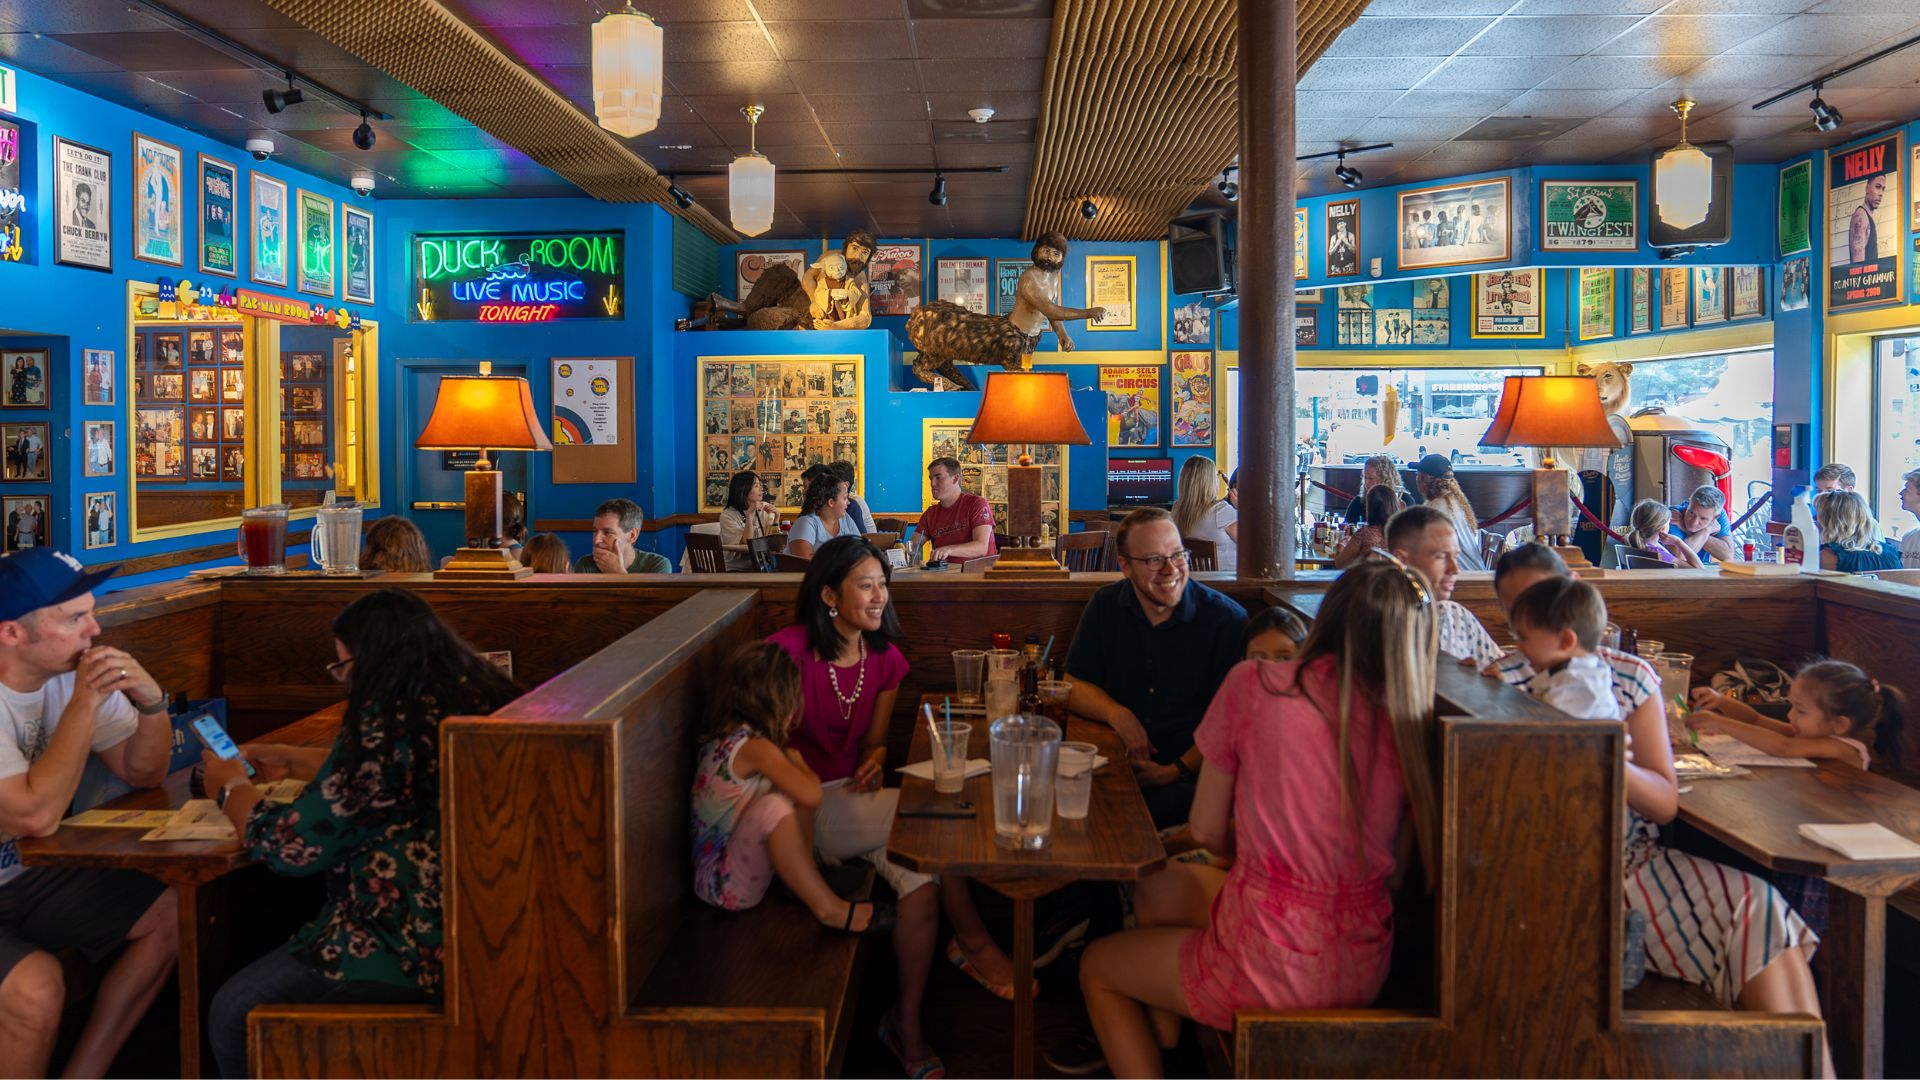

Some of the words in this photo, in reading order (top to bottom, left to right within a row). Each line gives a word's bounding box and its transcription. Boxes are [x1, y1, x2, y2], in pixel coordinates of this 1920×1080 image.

[62, 160, 73, 173] THE
[75, 164, 92, 178] CRANK
[94, 169, 106, 181] CLUB
[1844, 144, 1885, 181] NELLY
[1329, 203, 1356, 218] NELLY
[62, 225, 82, 237] CHUCK
[1548, 221, 1632, 237] TWANGFEST
[421, 239, 500, 279] DUCK
[529, 236, 615, 275] ROOM
[453, 282, 500, 300] LIVE
[512, 281, 583, 302] MUSIC
[240, 294, 282, 315] PAC-MAN
[283, 303, 309, 320] ROOM
[479, 305, 555, 321] TONIGHT
[1174, 353, 1210, 372] CIRCUS
[1115, 378, 1158, 389] CIRCUS
